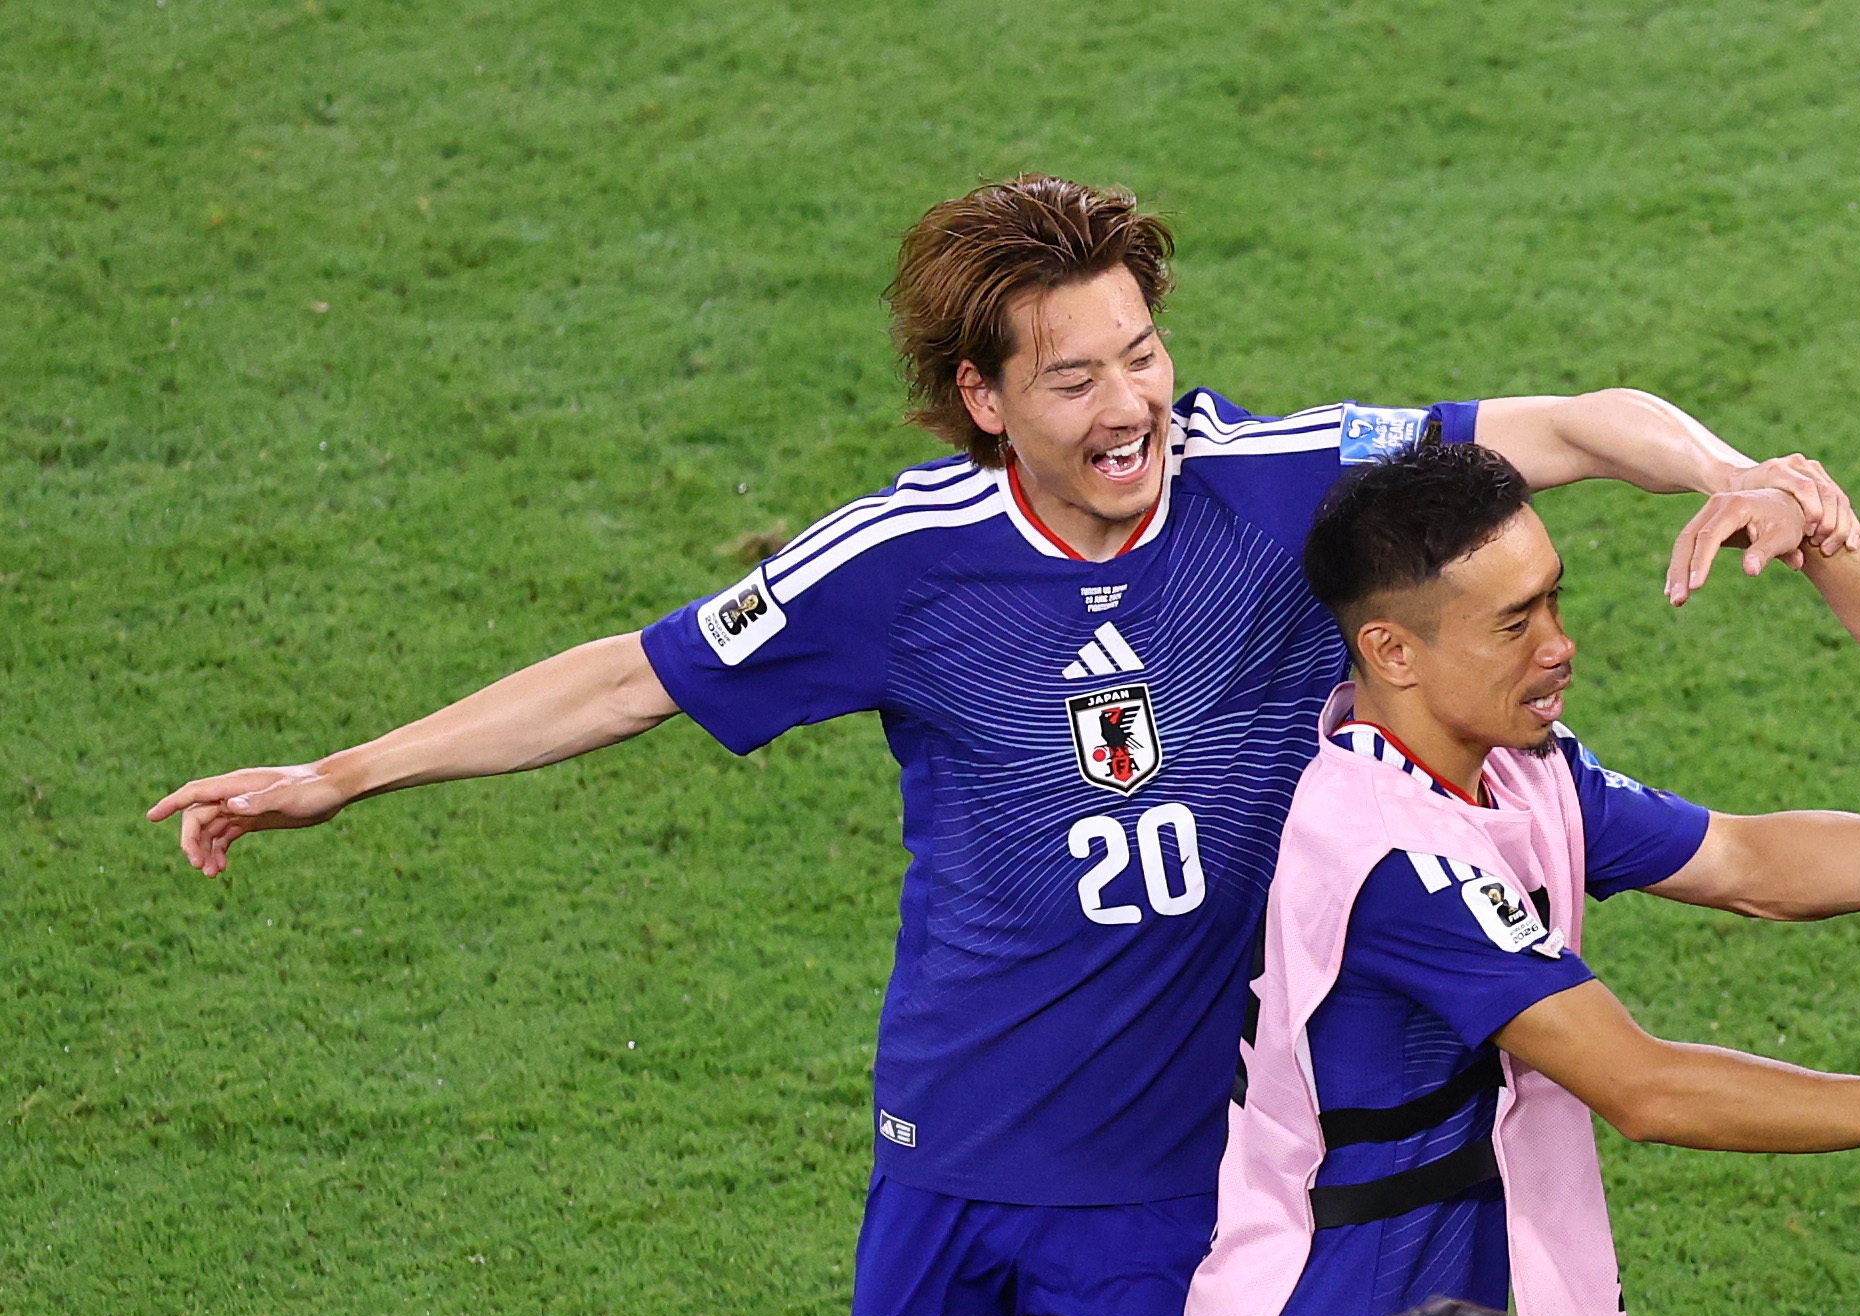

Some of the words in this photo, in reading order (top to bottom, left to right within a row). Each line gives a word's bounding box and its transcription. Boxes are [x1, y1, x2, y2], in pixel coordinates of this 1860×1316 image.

[705, 615, 727, 648] 2026
[1087, 689, 1130, 707] JAPAN
[1105, 757, 1141, 778] JFA
[1067, 802, 1206, 925] 20
[1512, 923, 1540, 944] 2026
